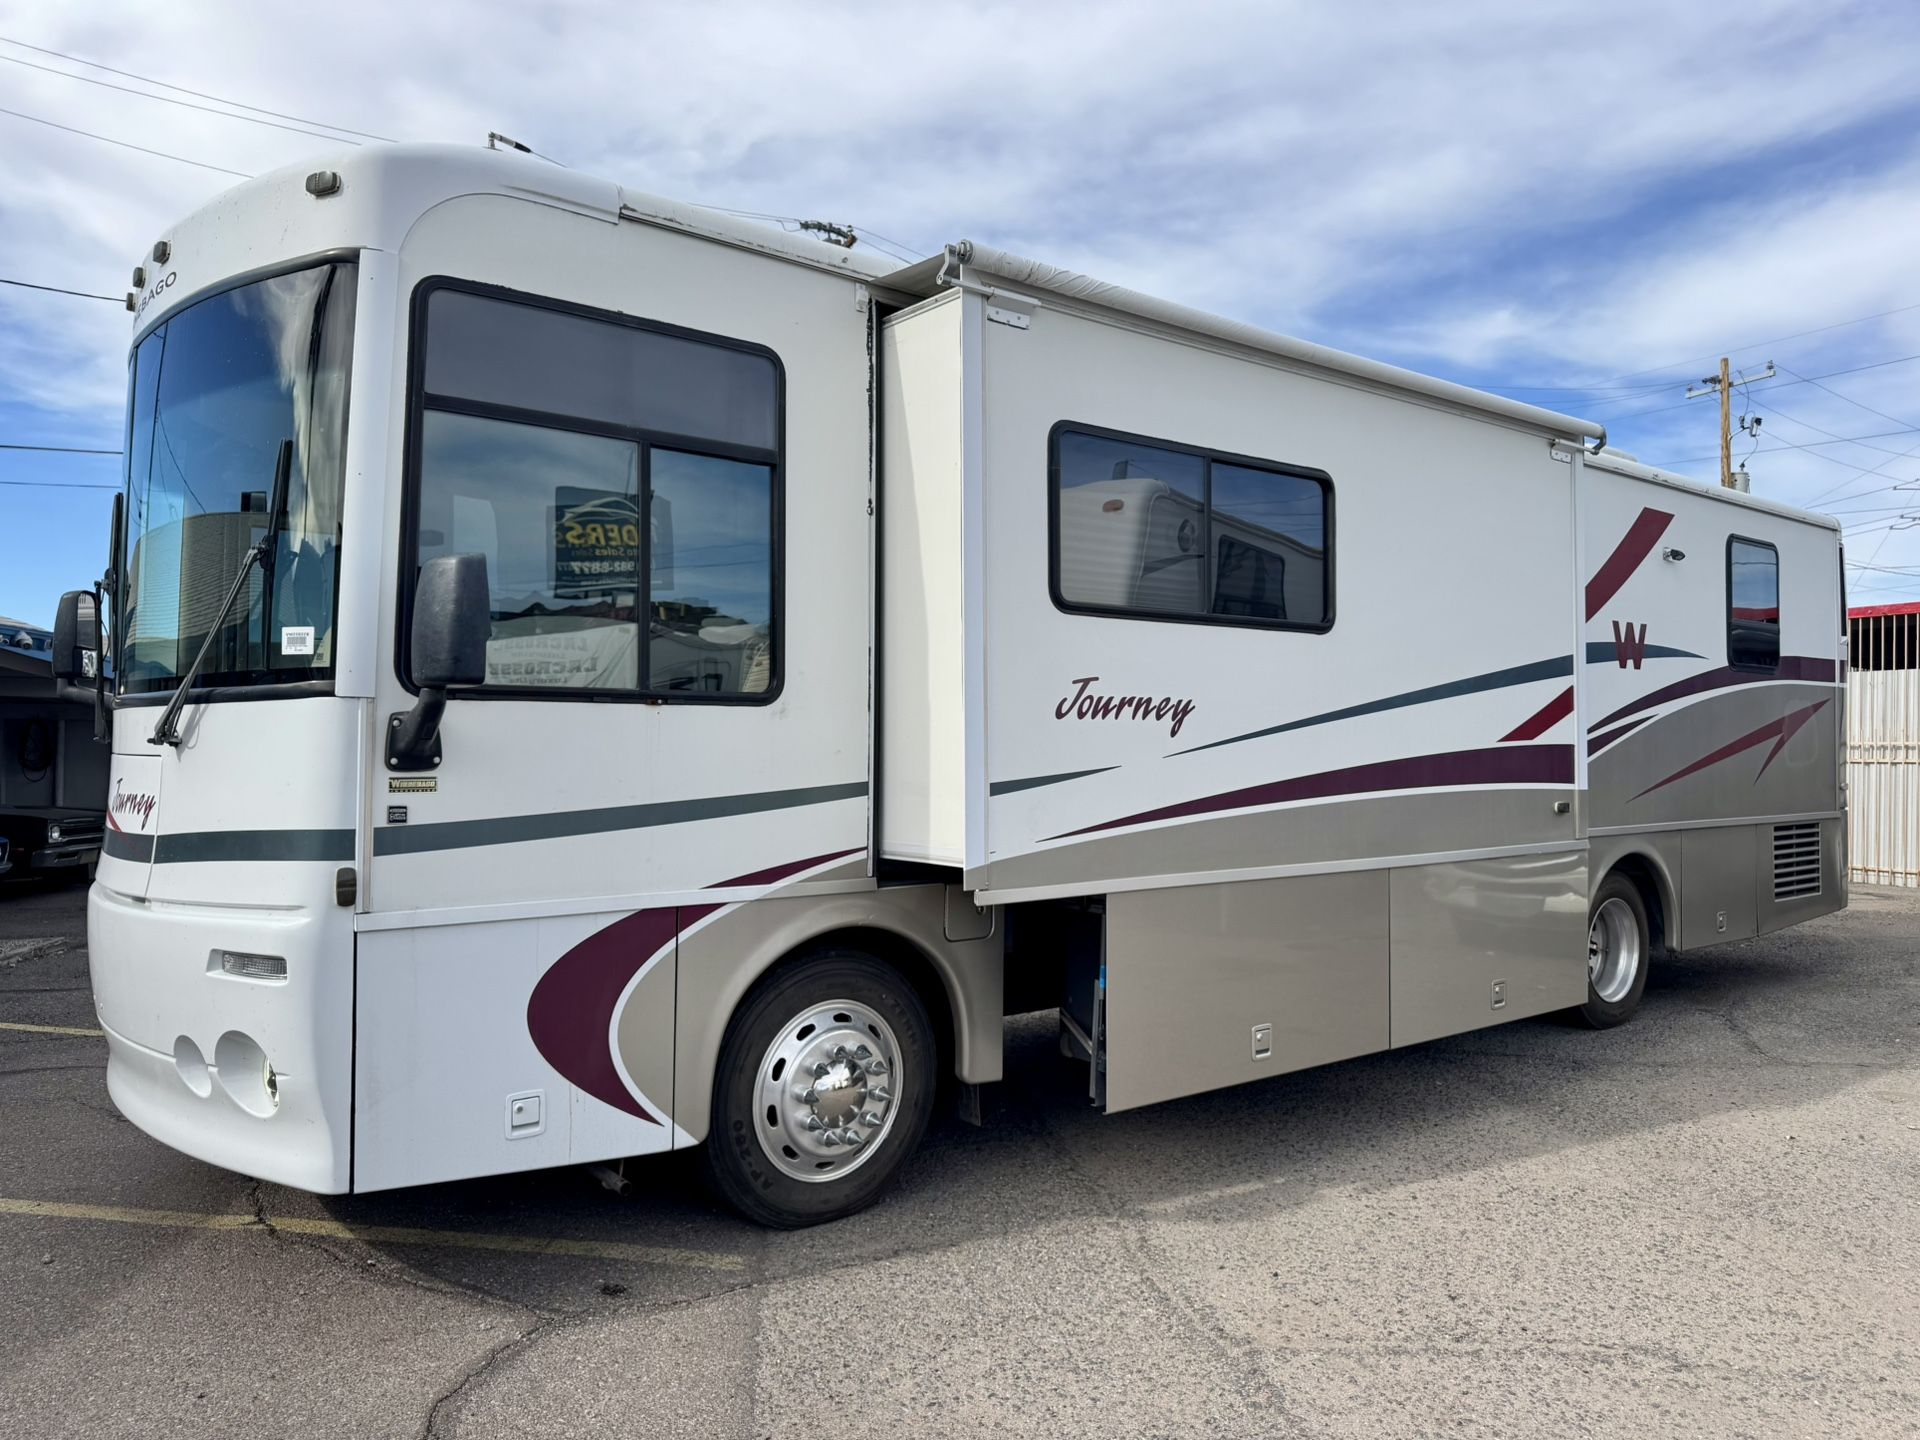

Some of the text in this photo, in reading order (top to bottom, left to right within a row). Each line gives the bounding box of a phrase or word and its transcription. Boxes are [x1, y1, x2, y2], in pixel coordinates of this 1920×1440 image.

[1612, 620, 1648, 670] W
[1055, 676, 1196, 738] Journey
[111, 777, 157, 831] Journey
